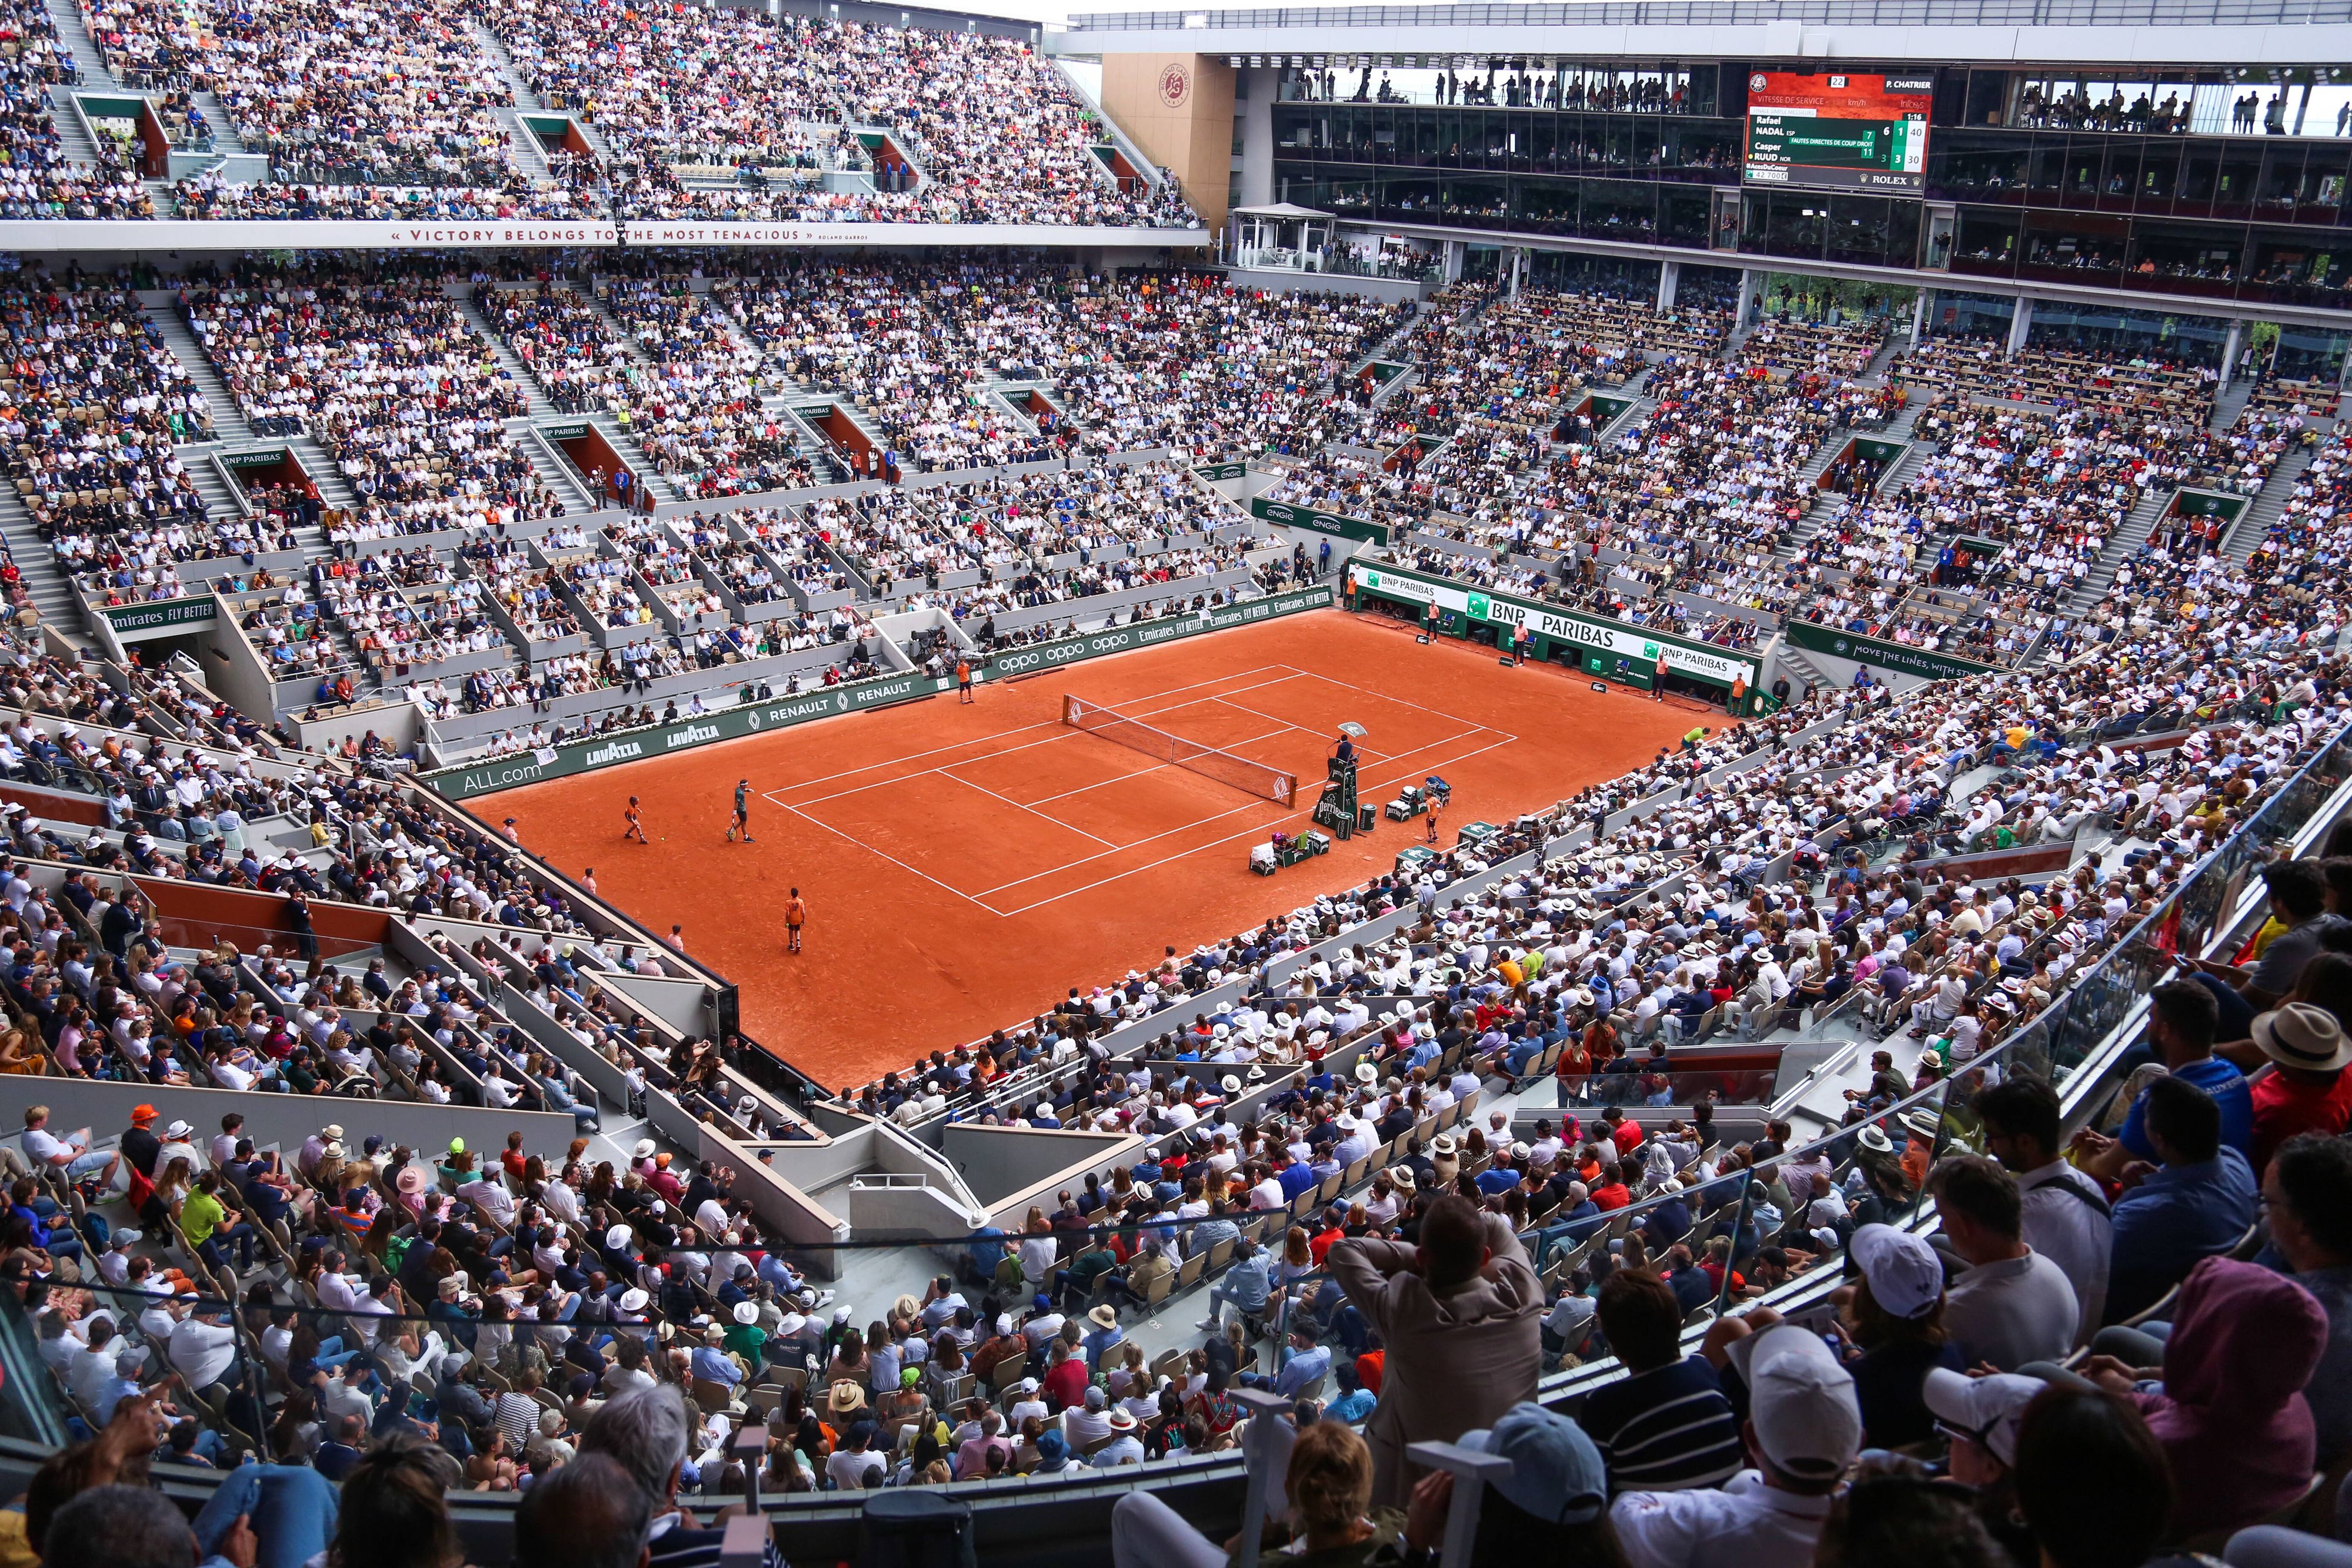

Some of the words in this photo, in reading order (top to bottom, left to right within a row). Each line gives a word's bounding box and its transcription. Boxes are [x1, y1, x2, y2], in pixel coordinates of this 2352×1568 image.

[1161, 66, 1175, 91] ROLAND
[1176, 66, 1188, 91] GARROS
[1832, 78, 1843, 86] 22
[1164, 96, 1183, 105] PARIS
[1900, 99, 1924, 109] Infosys
[1756, 116, 1781, 125] Rafael
[1756, 127, 1784, 136] NADAL
[1883, 127, 1890, 136] 6
[1898, 128, 1903, 136] 1
[1755, 142, 1781, 152] Casper
[1754, 153, 1778, 161] RUUD
[1895, 155, 1901, 163] 3
[1746, 163, 1788, 171] #AcesDuCoeur
[1872, 176, 1907, 185] ROLEX
[410, 230, 494, 241] VICTORY
[505, 230, 584, 240] BELONGS
[594, 230, 614, 240] TO
[625, 230, 654, 240] THE
[663, 230, 704, 240] MOST
[713, 230, 799, 240] TENACIOUS
[554, 427, 584, 435] PARIBAS
[243, 453, 281, 463] PARIBAS
[1382, 576, 1398, 587] BNP
[1400, 581, 1434, 596] PARIBAS
[1274, 597, 1305, 612] Emirates
[1305, 594, 1314, 606] FLY
[1314, 591, 1330, 604] BETTER
[168, 608, 182, 621] FLY
[184, 604, 213, 618] BETTER
[1210, 613, 1242, 627] Emirates
[1243, 608, 1252, 619] FLY
[1252, 604, 1269, 616] BETTER
[1138, 626, 1175, 641] Emirates
[1176, 621, 1185, 634] FLY
[1185, 618, 1204, 632] BETTER
[1492, 603, 1526, 624] BNP
[1542, 616, 1613, 647] PARIBAS
[1092, 633, 1128, 651] oppo
[1046, 643, 1085, 661] oppo
[999, 653, 1040, 672] oppo
[1662, 647, 1682, 659] BNP
[1684, 653, 1727, 671] PARIBAS
[1853, 645, 1880, 657] MOVE
[1883, 651, 1900, 664] THE
[1902, 654, 1929, 670] LINES,
[1932, 663, 1955, 677] WITH
[1692, 666, 1711, 674] changing
[973, 673, 983, 681] 22
[1635, 672, 1648, 680] PARIBAS
[938, 680, 948, 688] 22
[857, 681, 911, 703] RENAULT
[769, 699, 828, 722] RENAULT
[1766, 704, 1775, 712] ROLEX
[667, 724, 720, 748] LAVAZZA
[586, 742, 643, 765] LAVAZZA
[464, 763, 542, 793] ALL.com
[960, 1162, 966, 1174] 7
[1148, 1319, 1162, 1329] 05
